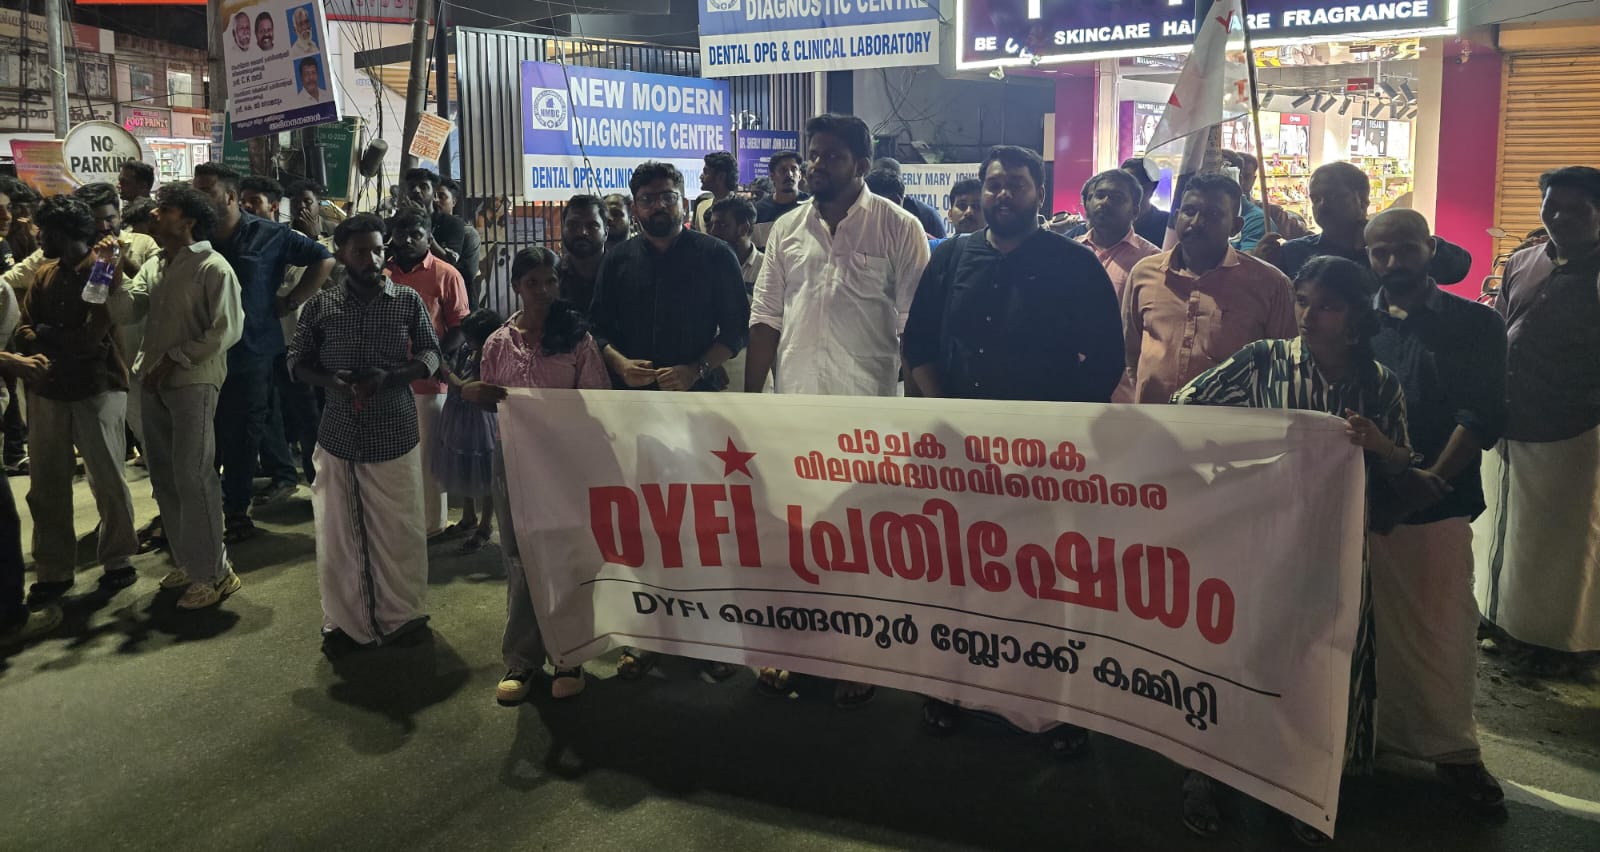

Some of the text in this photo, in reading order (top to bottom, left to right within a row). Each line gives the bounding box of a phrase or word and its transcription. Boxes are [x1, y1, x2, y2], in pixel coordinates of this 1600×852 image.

[745, 0, 850, 20] DIAGNOSTIC
[974, 36, 997, 51] BE
[1053, 22, 1151, 45] SKINCARE
[1283, 2, 1428, 27] FRAGRANCE
[708, 31, 931, 66] DENTAL OPG & CLINICAL LABORATORY
[570, 76, 625, 109] NEW
[632, 82, 724, 116] MODERN
[90, 135, 114, 152] NO
[571, 116, 724, 151] DIAGNOSTIC CENTRE
[532, 167, 633, 189] DENTAL OPG & CLINIC
[902, 173, 922, 185] ERLY
[925, 173, 951, 185] MARY
[838, 429, 1086, 472] പാചക വാതക
[795, 451, 1167, 510] വിലവർദ്ധനവിനെതിരെ
[590, 484, 1235, 644] DYFI പ്രതിഷേധം
[632, 591, 1219, 731] DYFI ചെങ്ങന്നൂർ ബ്ലോക്ക് കമ്മിറ്റി
